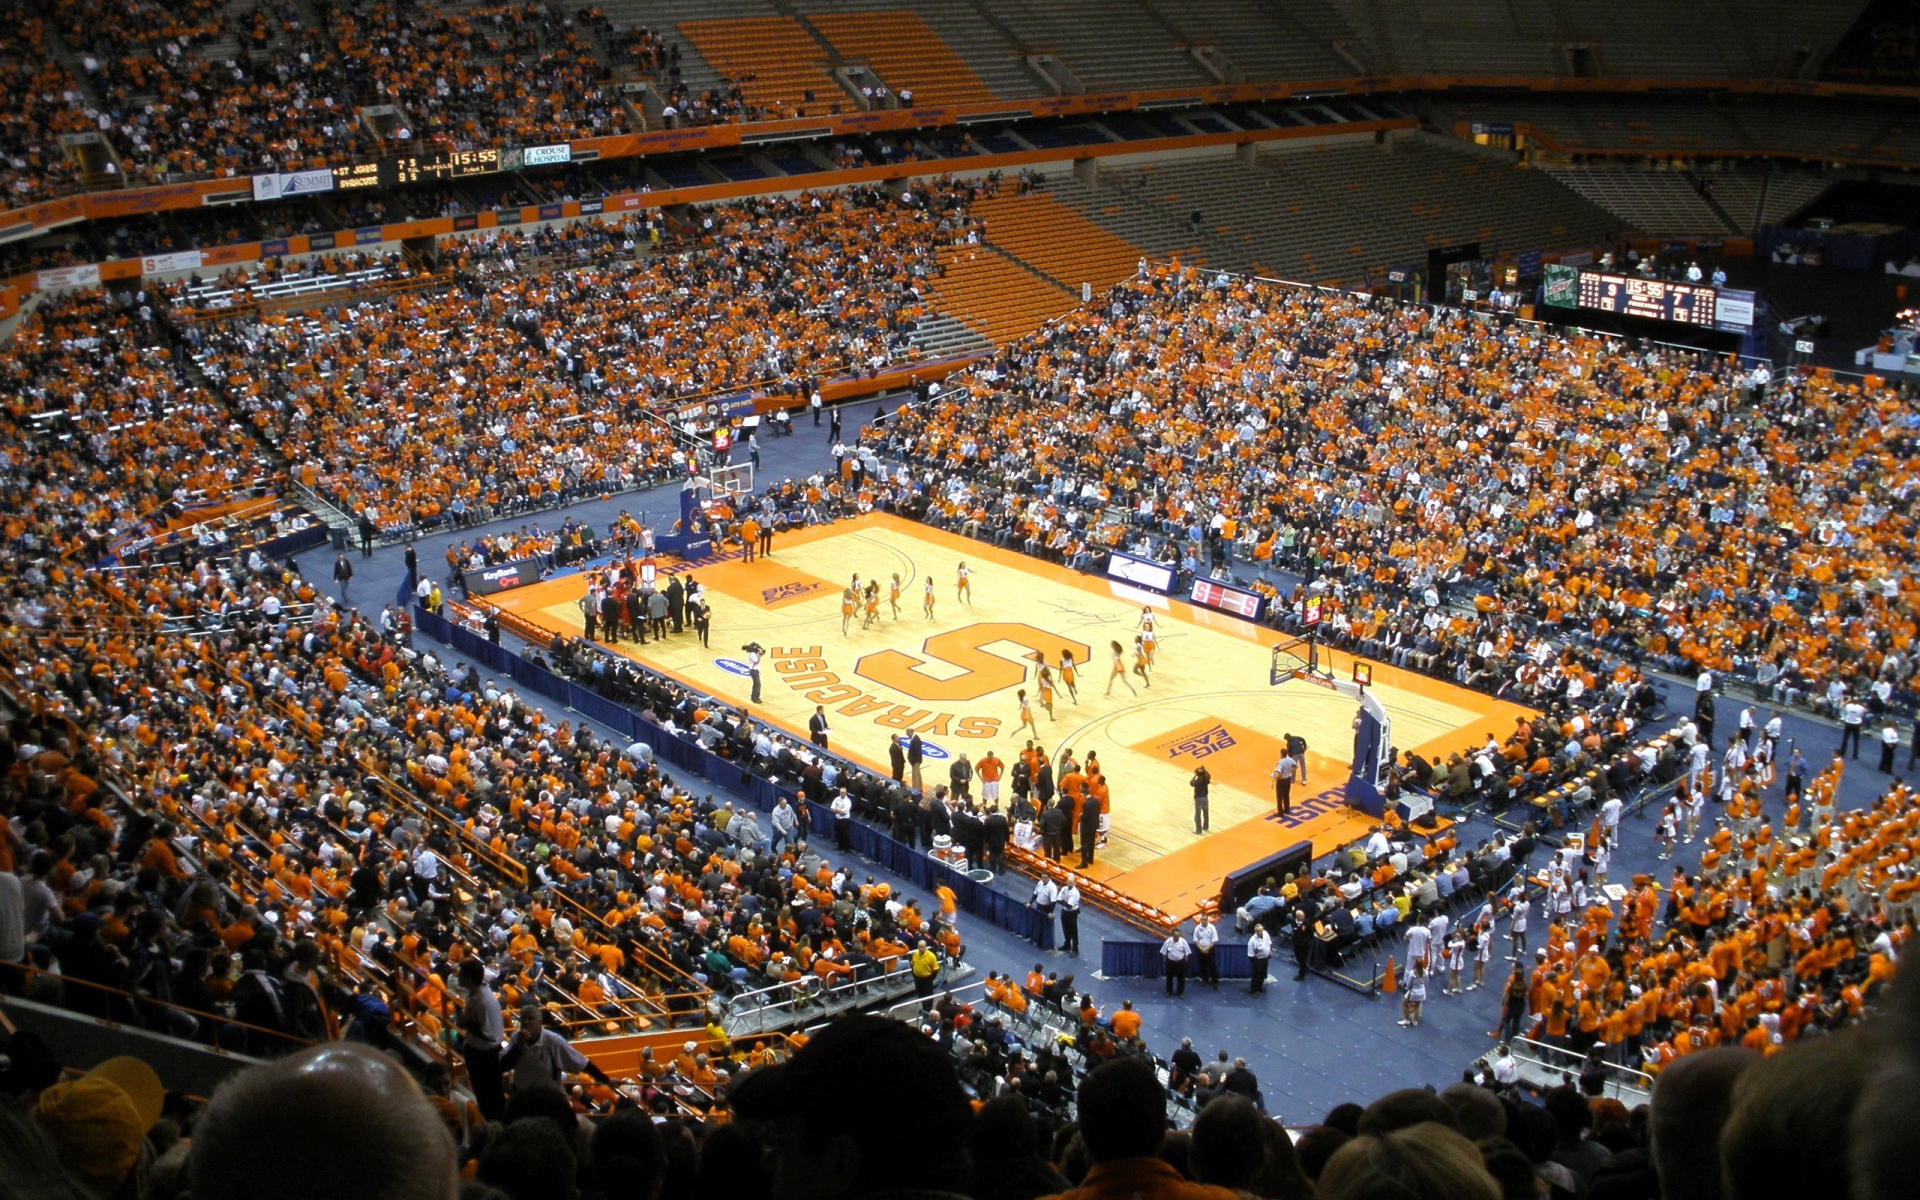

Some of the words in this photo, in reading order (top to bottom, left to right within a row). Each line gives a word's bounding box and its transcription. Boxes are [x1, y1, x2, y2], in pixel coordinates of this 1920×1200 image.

[453, 150, 497, 165] 15:55
[534, 153, 568, 163] HOSPITAL
[535, 146, 566, 155] CROUSE
[339, 167, 350, 176] ST
[339, 176, 378, 188] SYRACUSE
[1464, 290, 1477, 300] 123
[1607, 284, 1617, 296] 9
[1629, 281, 1662, 296] 15:55
[1673, 292, 1682, 305] 7
[1797, 341, 1812, 352] 124
[119, 533, 154, 557] KeyBank
[482, 566, 518, 581] KeyBank
[761, 581, 801, 596] BIG
[764, 582, 821, 603] EAST
[770, 645, 1002, 739] SYRACUSE
[1168, 727, 1230, 759] EAST
[1192, 736, 1237, 760] BIG
